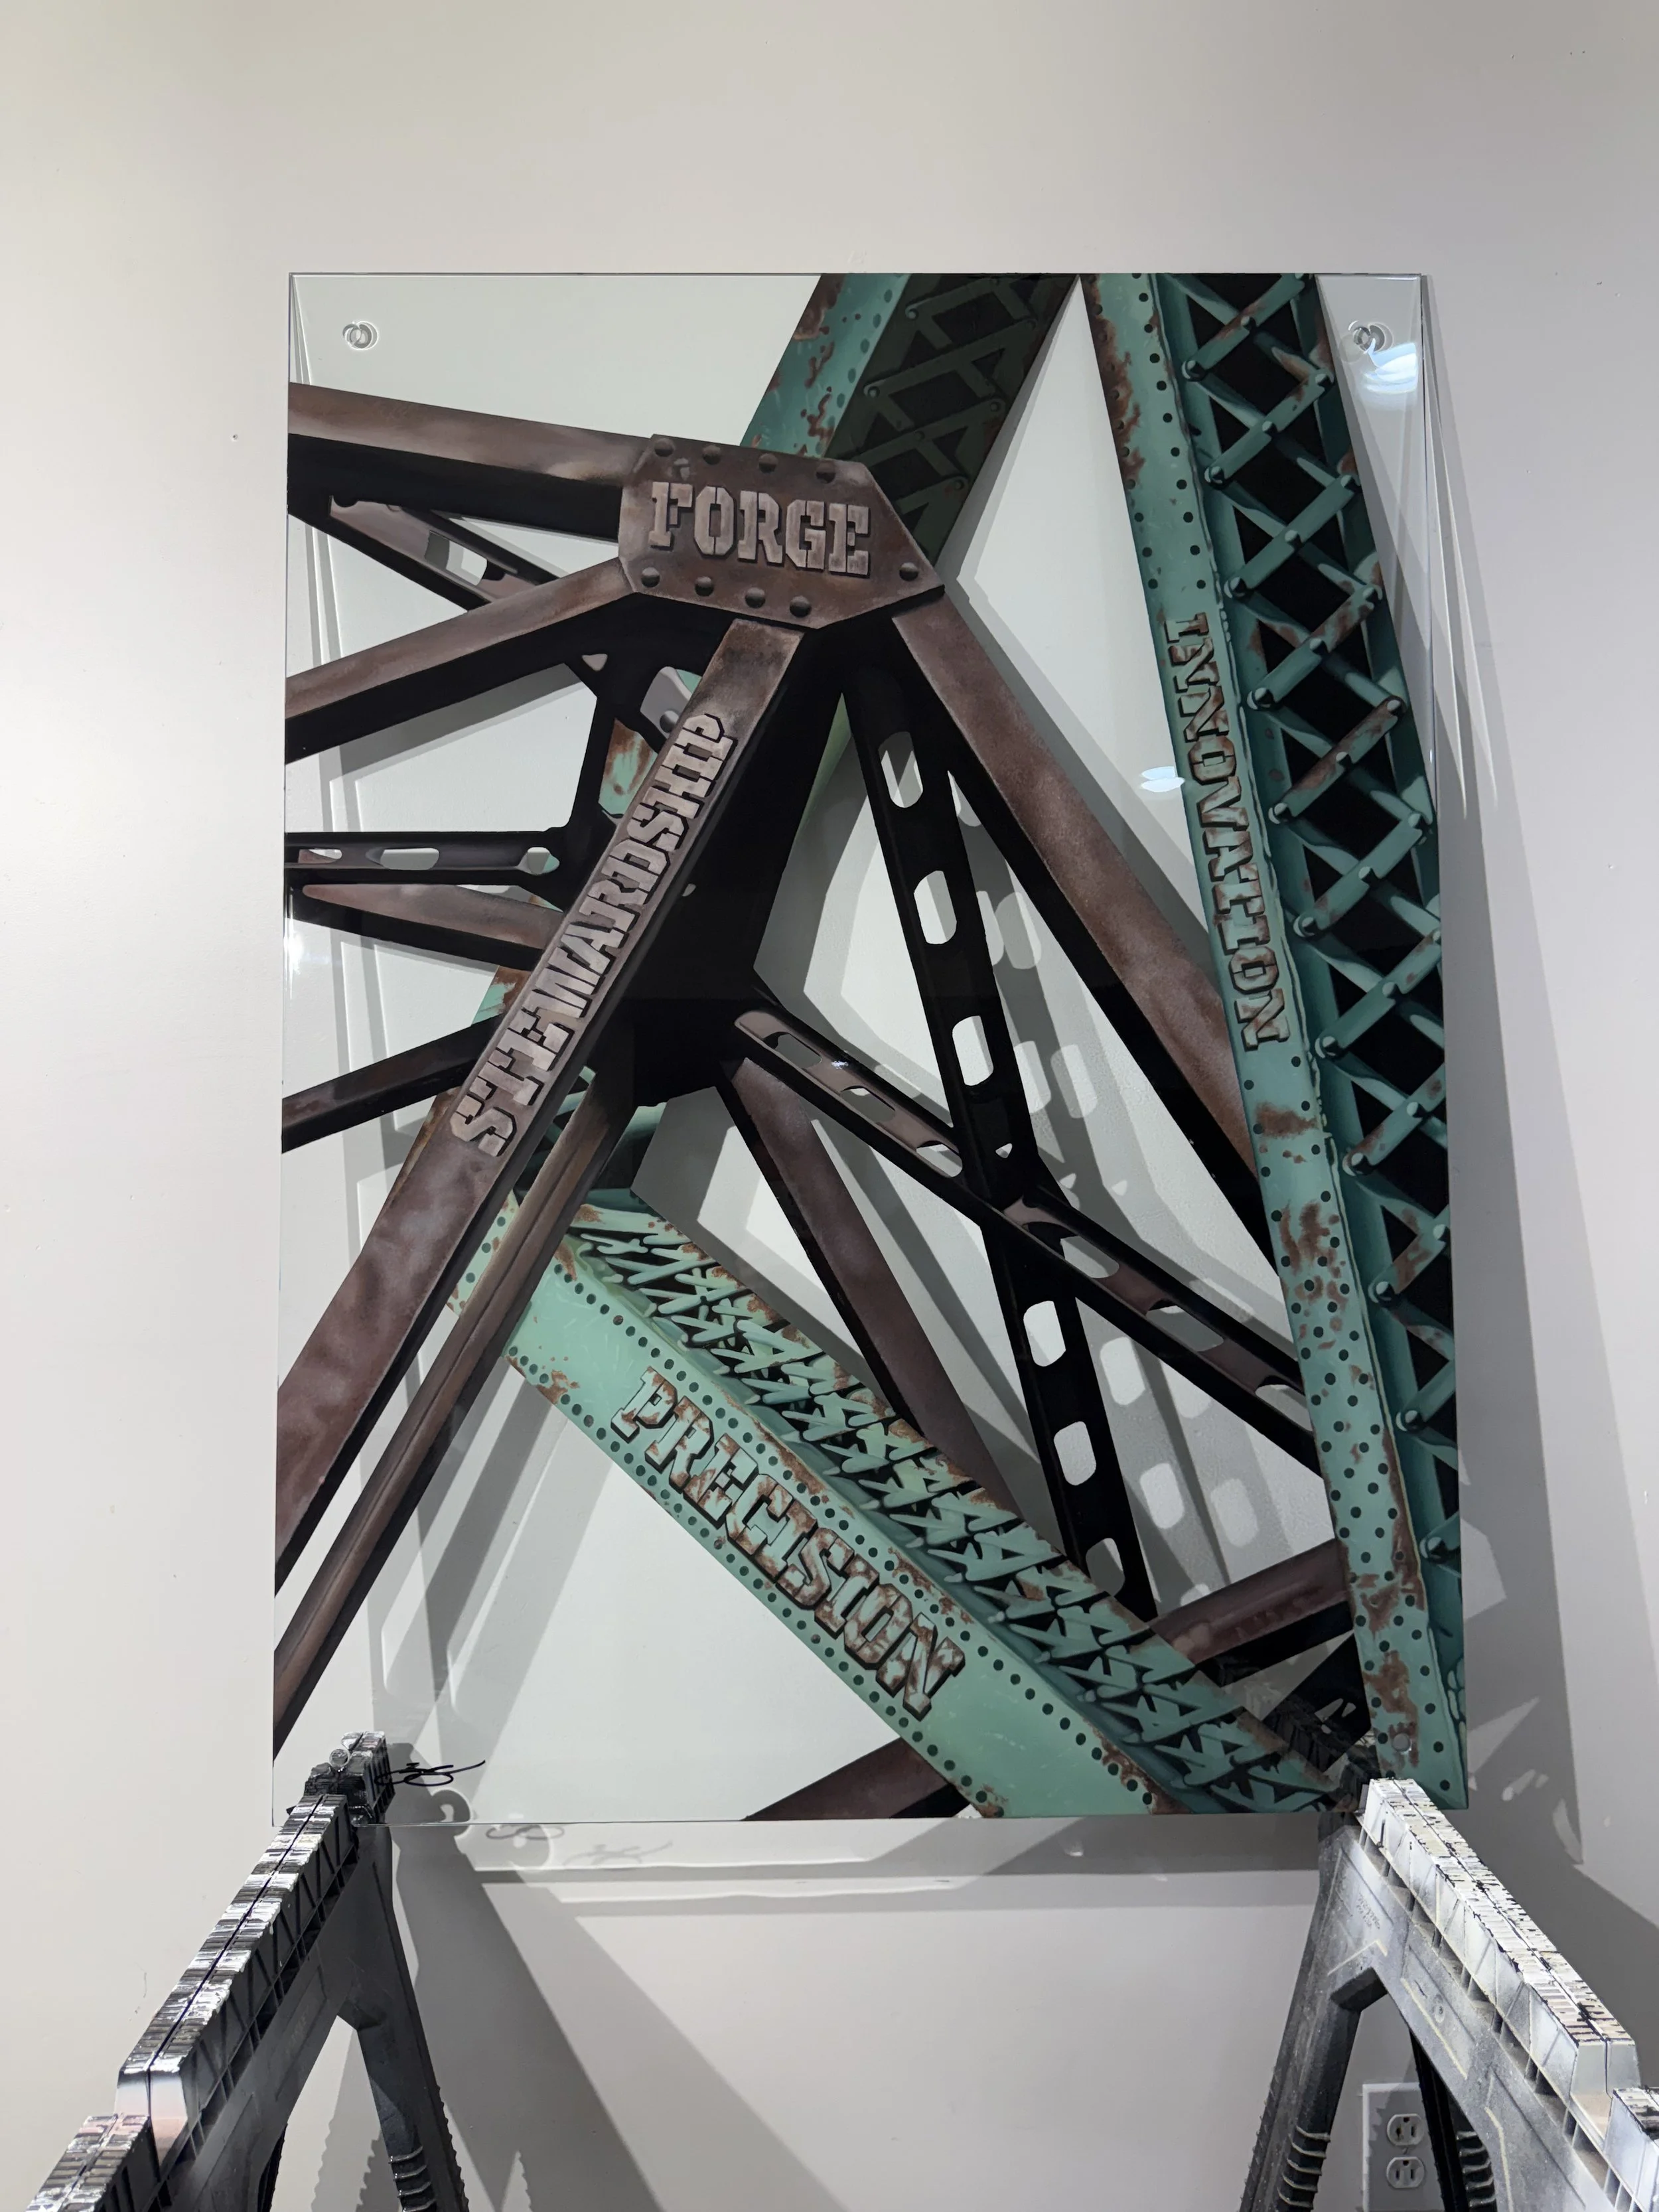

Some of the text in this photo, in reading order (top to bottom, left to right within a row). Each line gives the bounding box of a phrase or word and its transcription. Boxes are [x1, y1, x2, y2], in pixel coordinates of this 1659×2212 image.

[647, 481, 870, 578] FORGE
[450, 713, 737, 1157] STEWARDSHIP
[1165, 612, 1290, 1051] INNOVATION
[611, 1366, 966, 1722] PRECISION
